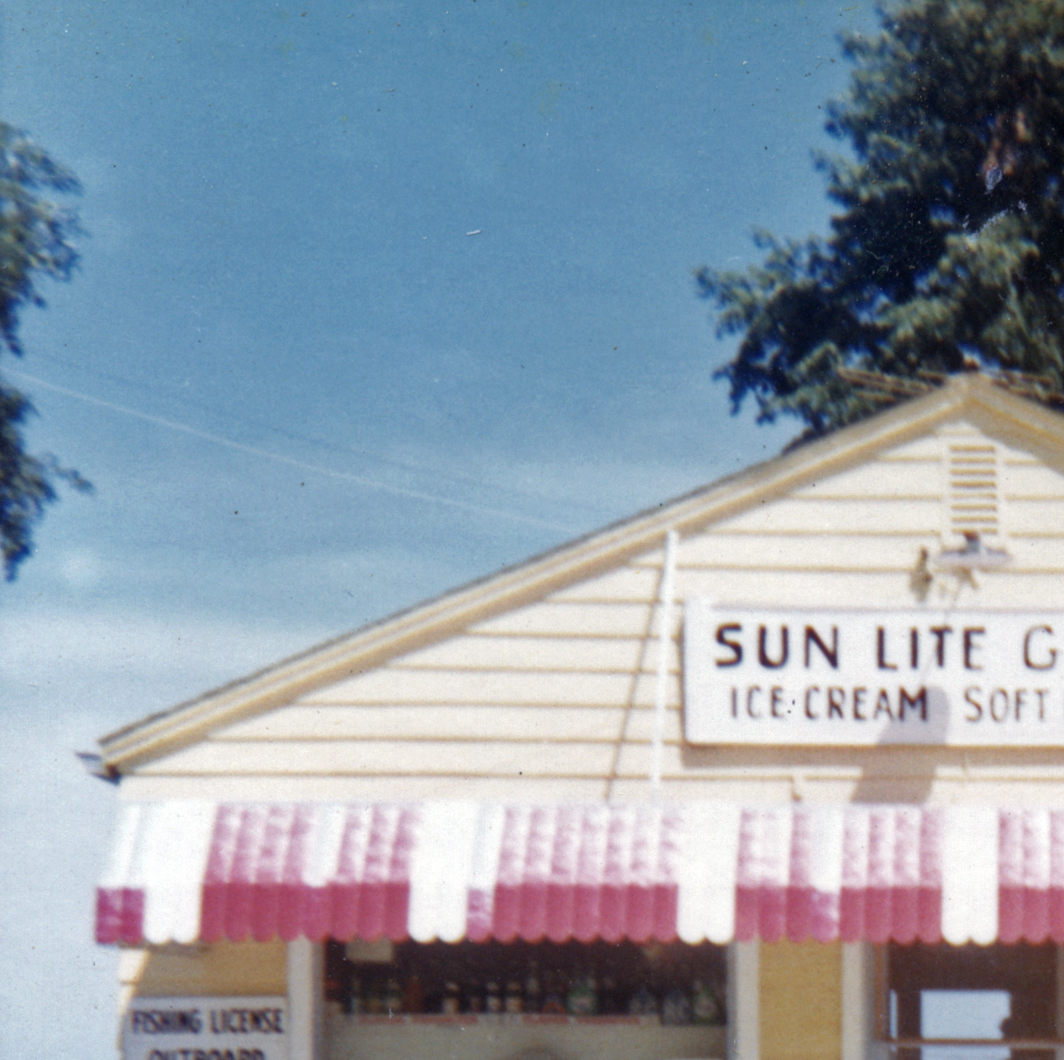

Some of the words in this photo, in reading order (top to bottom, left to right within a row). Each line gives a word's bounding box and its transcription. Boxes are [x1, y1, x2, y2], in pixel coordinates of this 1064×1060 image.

[715, 623, 840, 670] SUN
[877, 625, 986, 671] LITE
[730, 686, 787, 720] ICE
[804, 686, 929, 722] CREAM
[965, 686, 1048, 722] SOFT
[131, 1009, 202, 1034] FISHING
[210, 1008, 283, 1034] LICENSE
